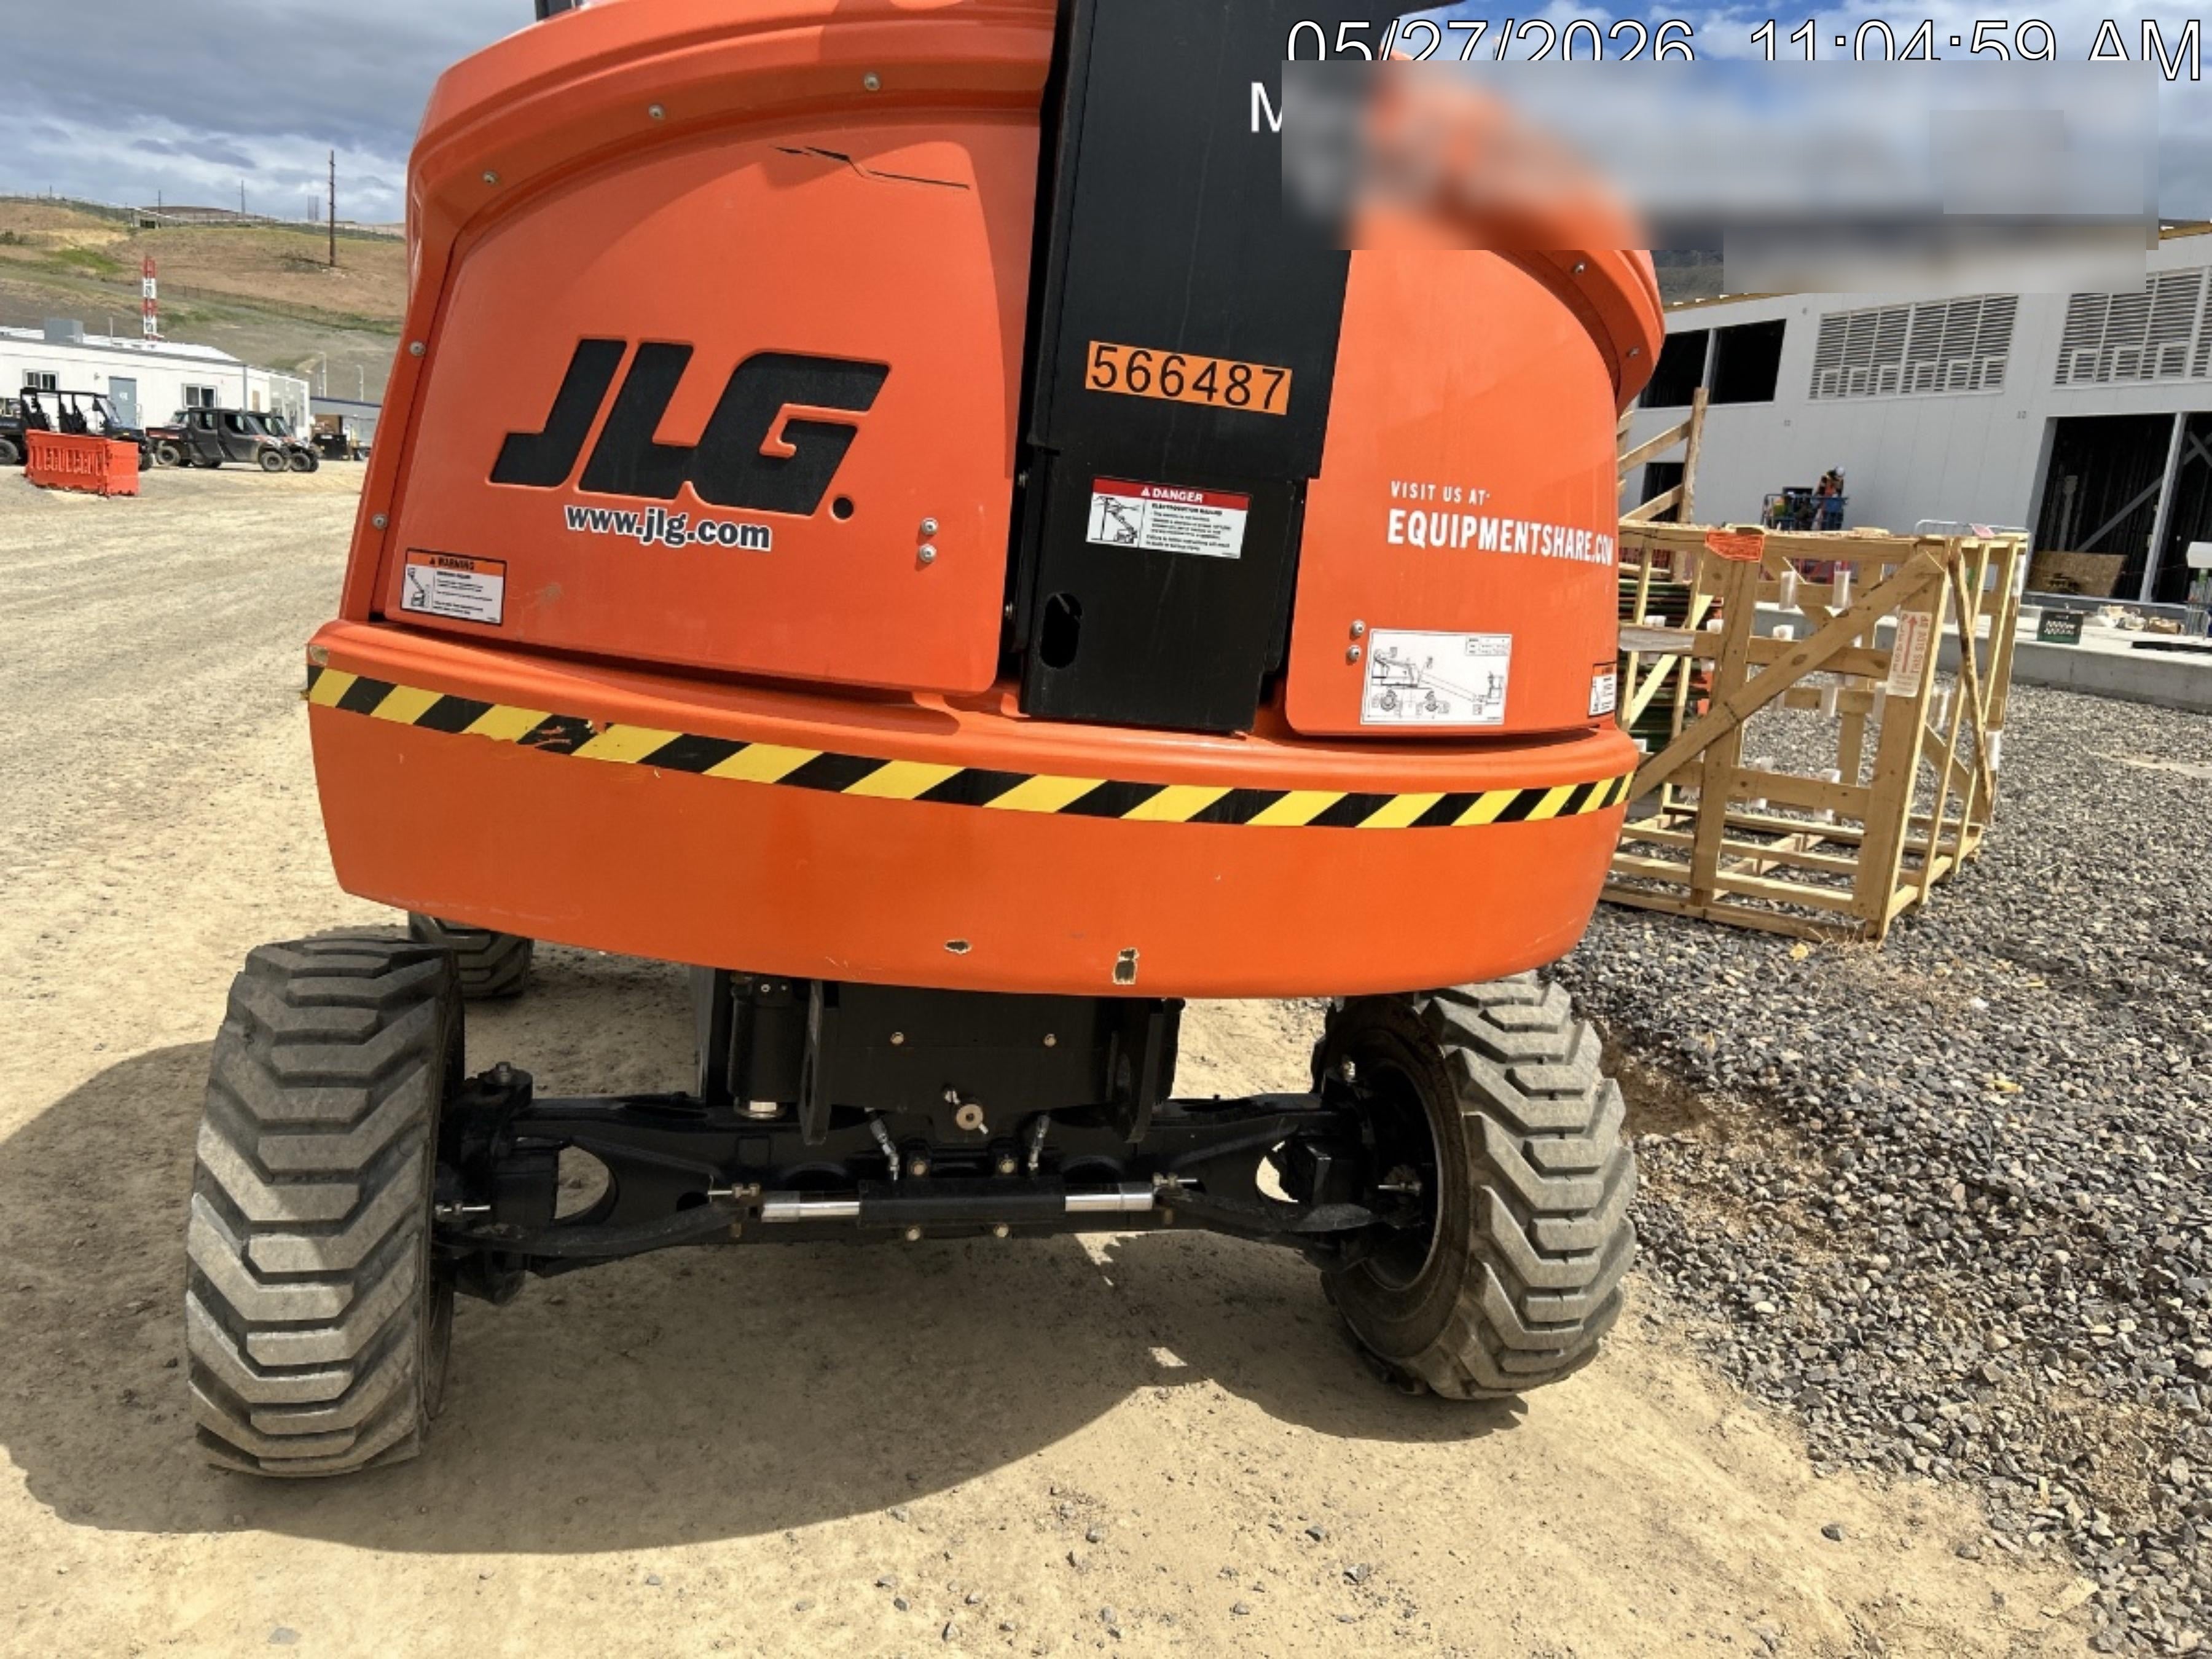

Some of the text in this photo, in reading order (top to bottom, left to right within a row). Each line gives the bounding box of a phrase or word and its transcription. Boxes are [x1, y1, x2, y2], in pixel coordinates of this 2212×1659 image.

[1091, 343, 1286, 410] 566487
[1151, 488, 1204, 504] DANGER
[1390, 480, 1437, 501] VISIT
[1443, 485, 1462, 503] US
[563, 504, 772, 551] www.jlg.com
[1387, 508, 1615, 567] EQUIPMENTSHARE.COM
[438, 556, 475, 571] WARNING
